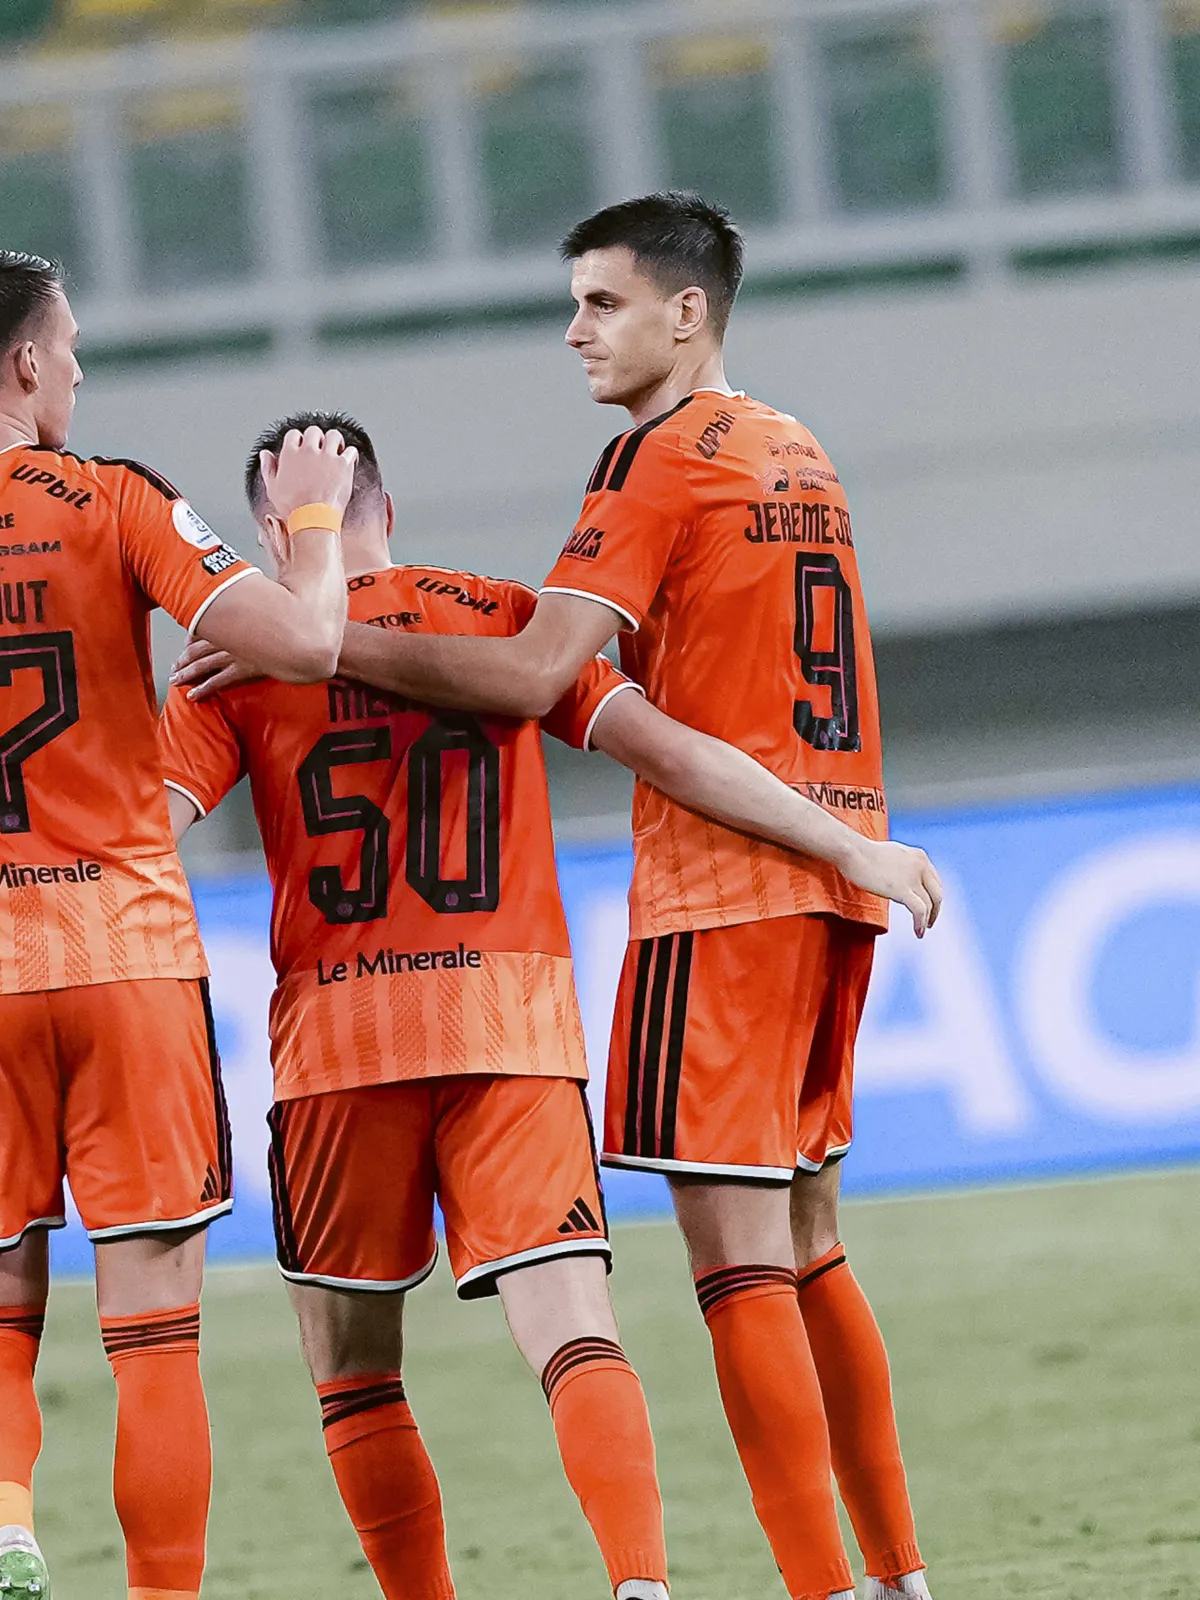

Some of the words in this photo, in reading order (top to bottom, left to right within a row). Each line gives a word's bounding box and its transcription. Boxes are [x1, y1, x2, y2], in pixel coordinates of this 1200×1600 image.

[793, 552, 861, 752] 9
[300, 715, 501, 926] 50
[317, 958, 347, 986] Le
[355, 943, 481, 978] Minerale
